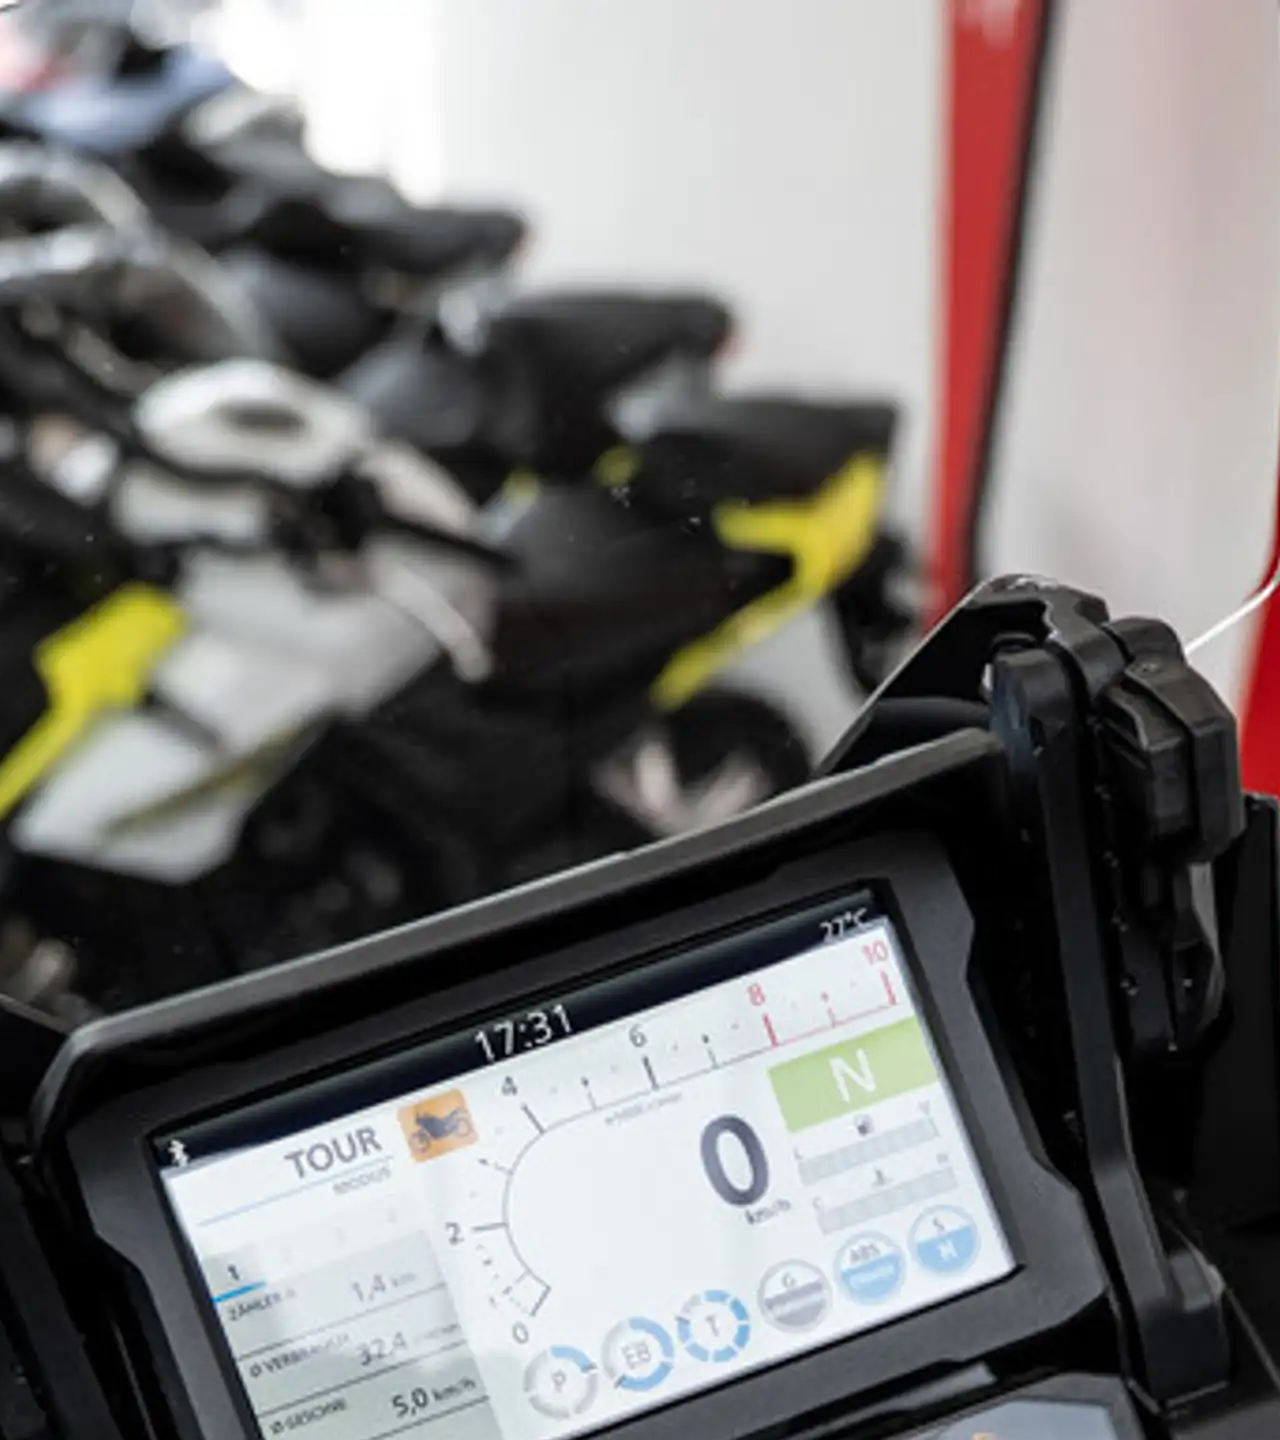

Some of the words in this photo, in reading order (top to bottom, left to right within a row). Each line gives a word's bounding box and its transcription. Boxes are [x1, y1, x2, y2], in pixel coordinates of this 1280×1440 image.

[861, 940, 888, 965] 10
[747, 982, 766, 1006] 8
[474, 1003, 572, 1064] 17:31
[628, 1025, 648, 1048] 6
[501, 1076, 518, 1096] 4
[829, 1048, 876, 1103] N
[285, 1127, 383, 1179] TOUR
[701, 1114, 769, 1207] 0
[445, 1222, 464, 1245] 2
[227, 1263, 240, 1281] 1
[352, 1274, 387, 1303] 1,4
[512, 1322, 529, 1345] 0
[552, 1371, 567, 1393] P
[622, 1341, 652, 1369] EB
[705, 1313, 719, 1336] T
[391, 1386, 429, 1419] 5,0
